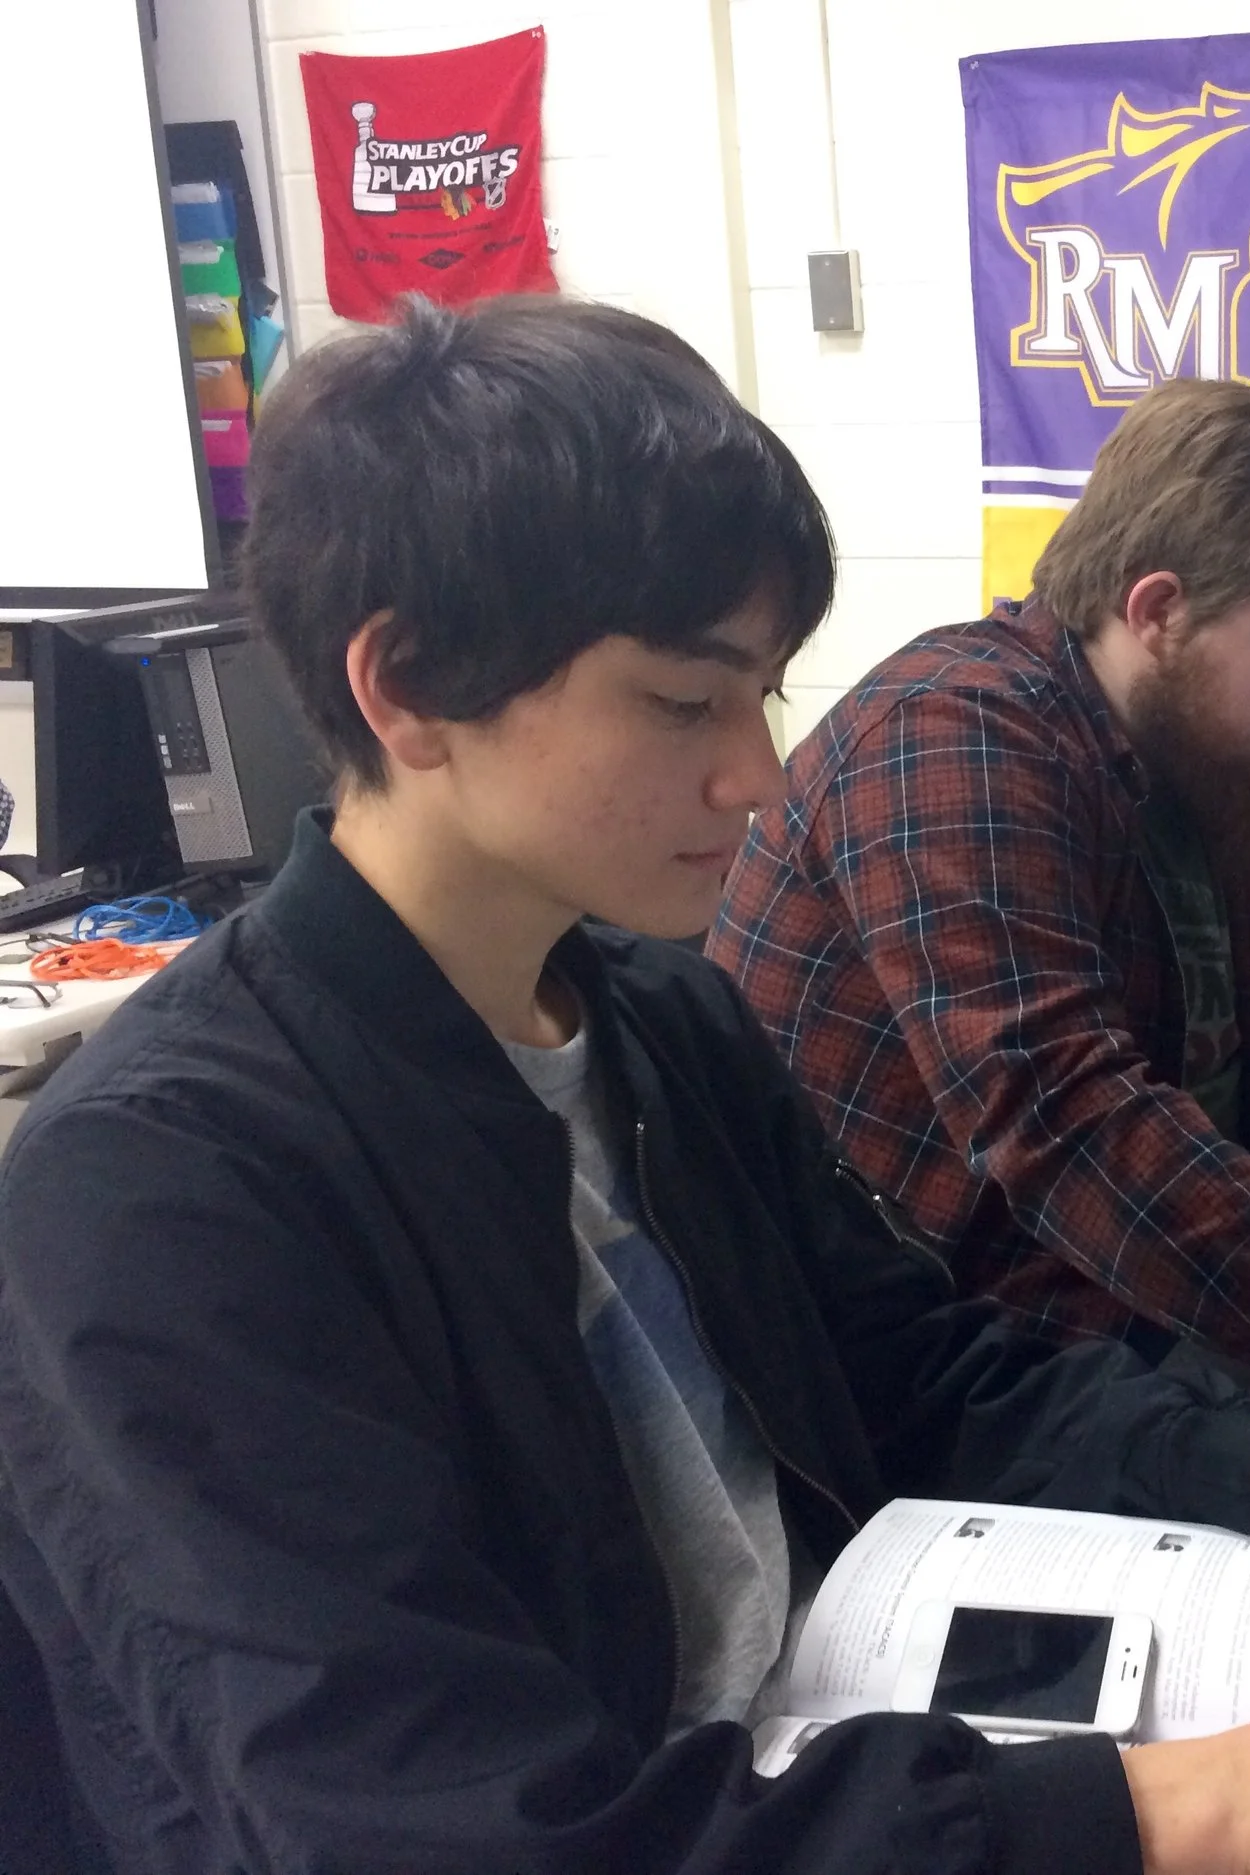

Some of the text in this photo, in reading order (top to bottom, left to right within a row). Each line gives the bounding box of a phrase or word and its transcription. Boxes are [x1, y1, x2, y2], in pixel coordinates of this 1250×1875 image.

[450, 133, 487, 156] CUP
[371, 148, 519, 192] PLAYOFFS
[1026, 228, 1238, 392] RM
